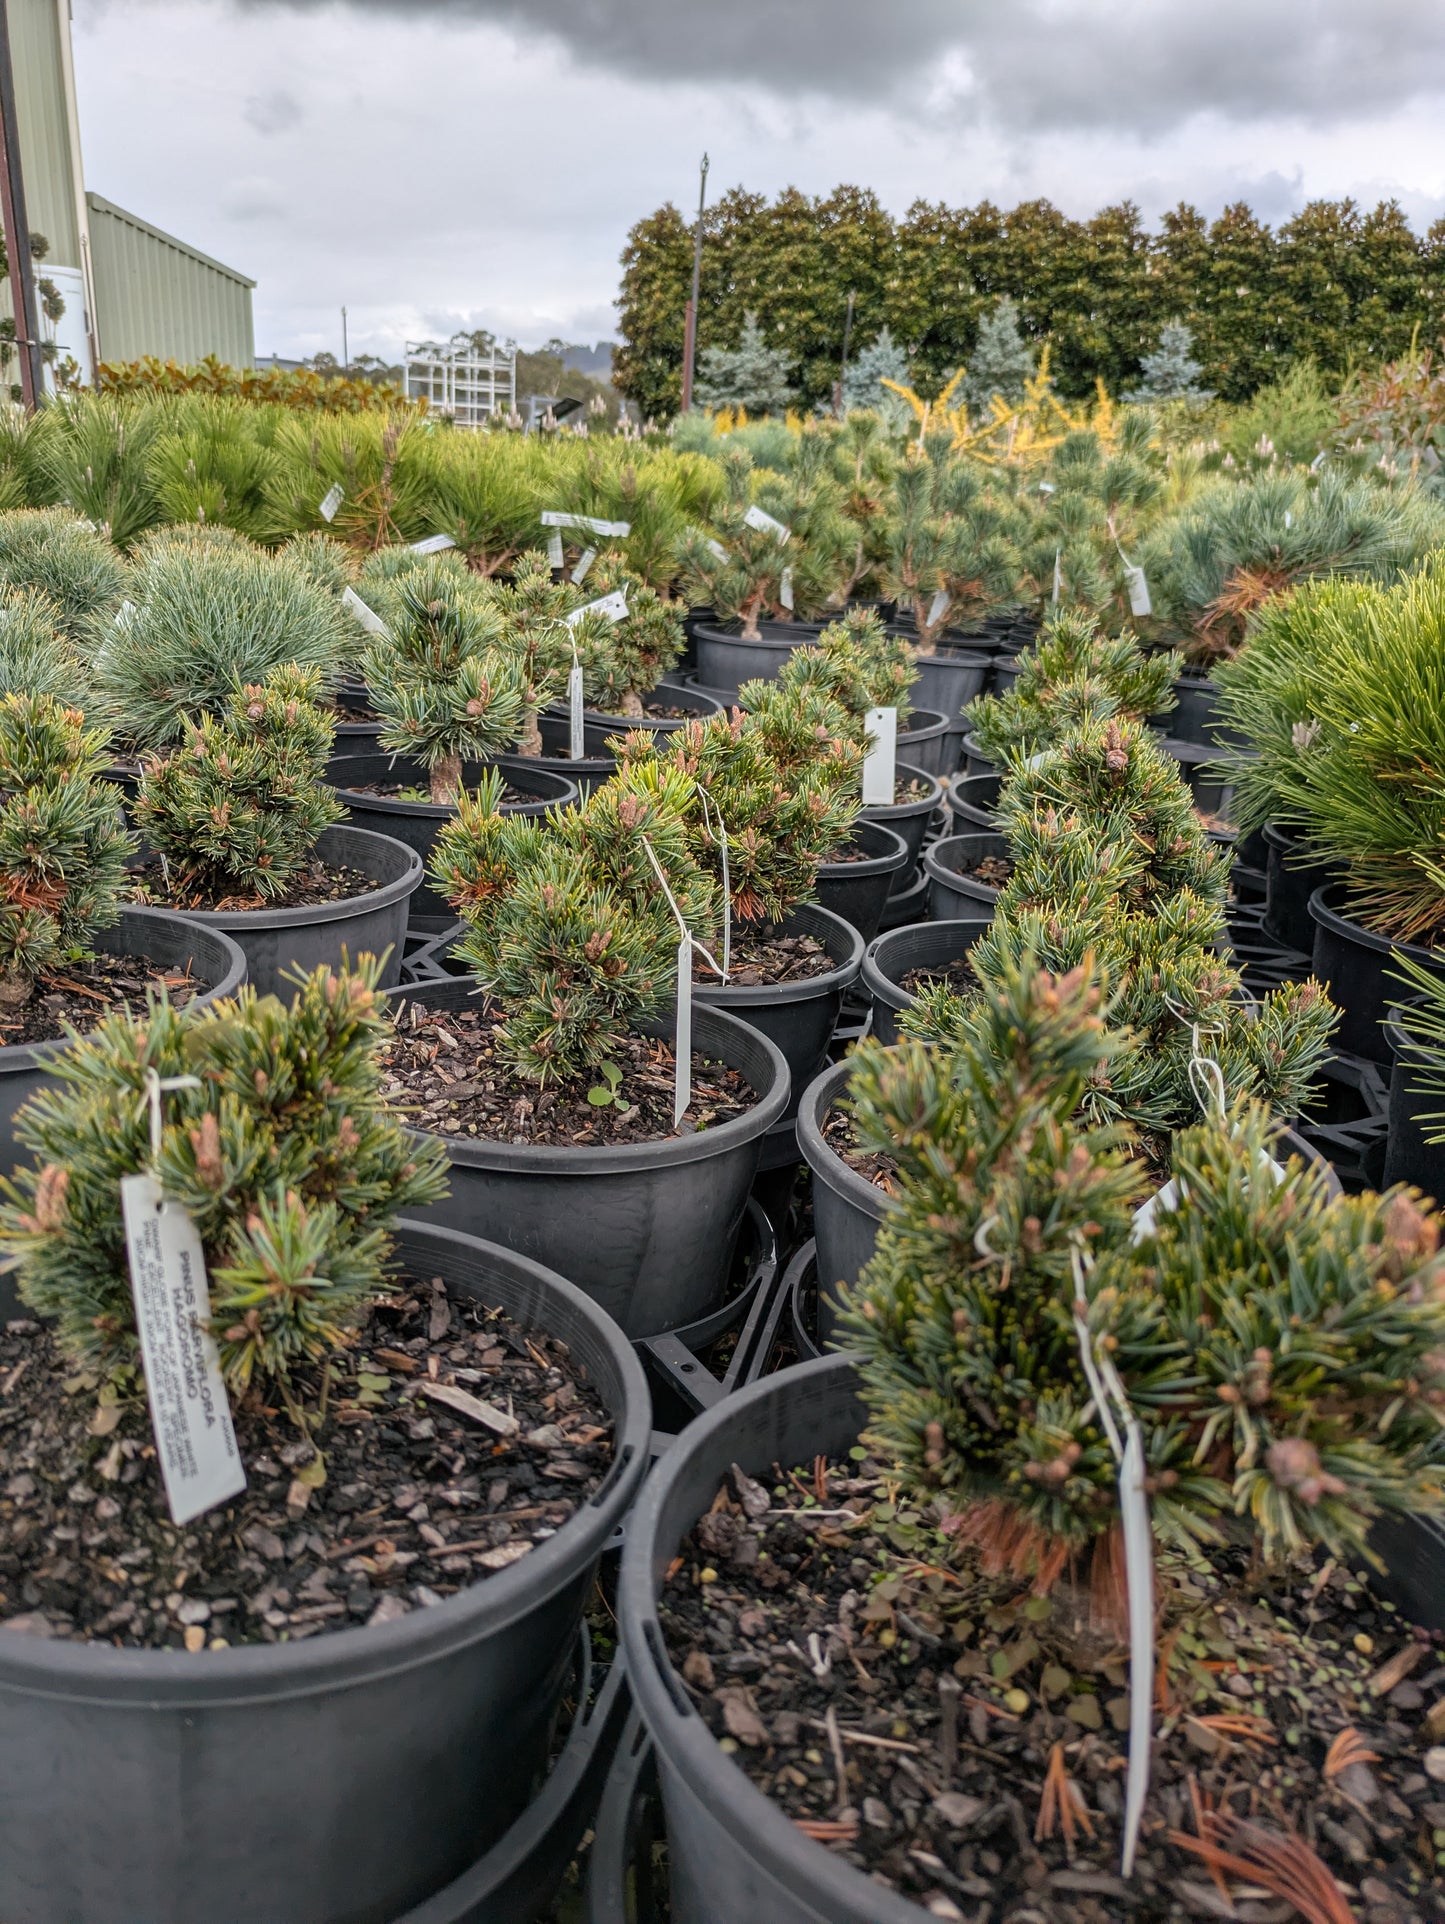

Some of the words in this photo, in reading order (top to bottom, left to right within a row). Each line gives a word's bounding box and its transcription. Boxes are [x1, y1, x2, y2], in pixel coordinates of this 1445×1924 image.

[172, 1288, 198, 1399] HAGOROMO
[179, 1251, 196, 1304] PINUS
[188, 1312, 216, 1428] PARVIFLORA
